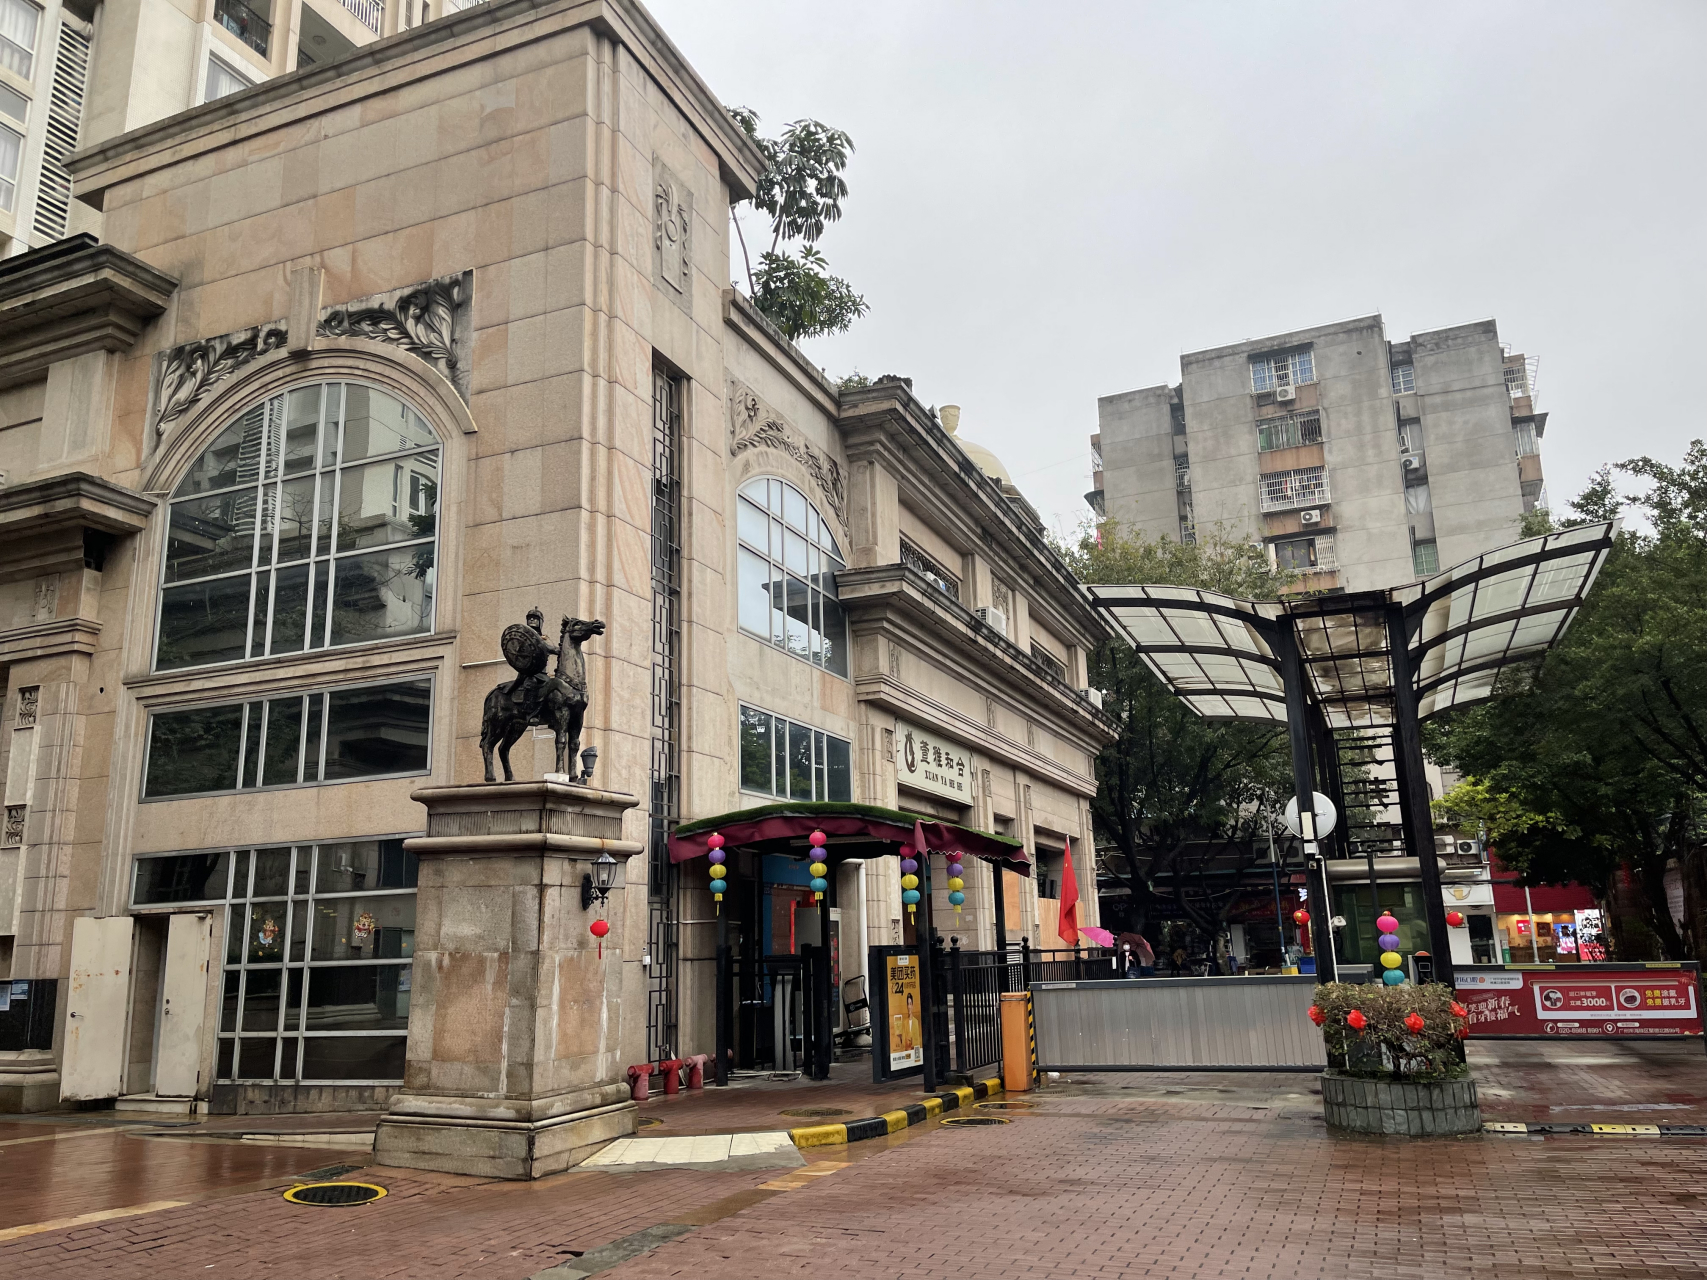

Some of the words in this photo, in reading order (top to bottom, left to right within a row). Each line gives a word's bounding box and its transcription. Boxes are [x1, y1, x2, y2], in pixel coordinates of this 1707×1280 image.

[924, 769, 939, 783] XUAN
[940, 775, 948, 786] YA
[948, 779, 956, 789] HE
[956, 781, 963, 792] HE
[890, 966, 917, 981] 美团买药
